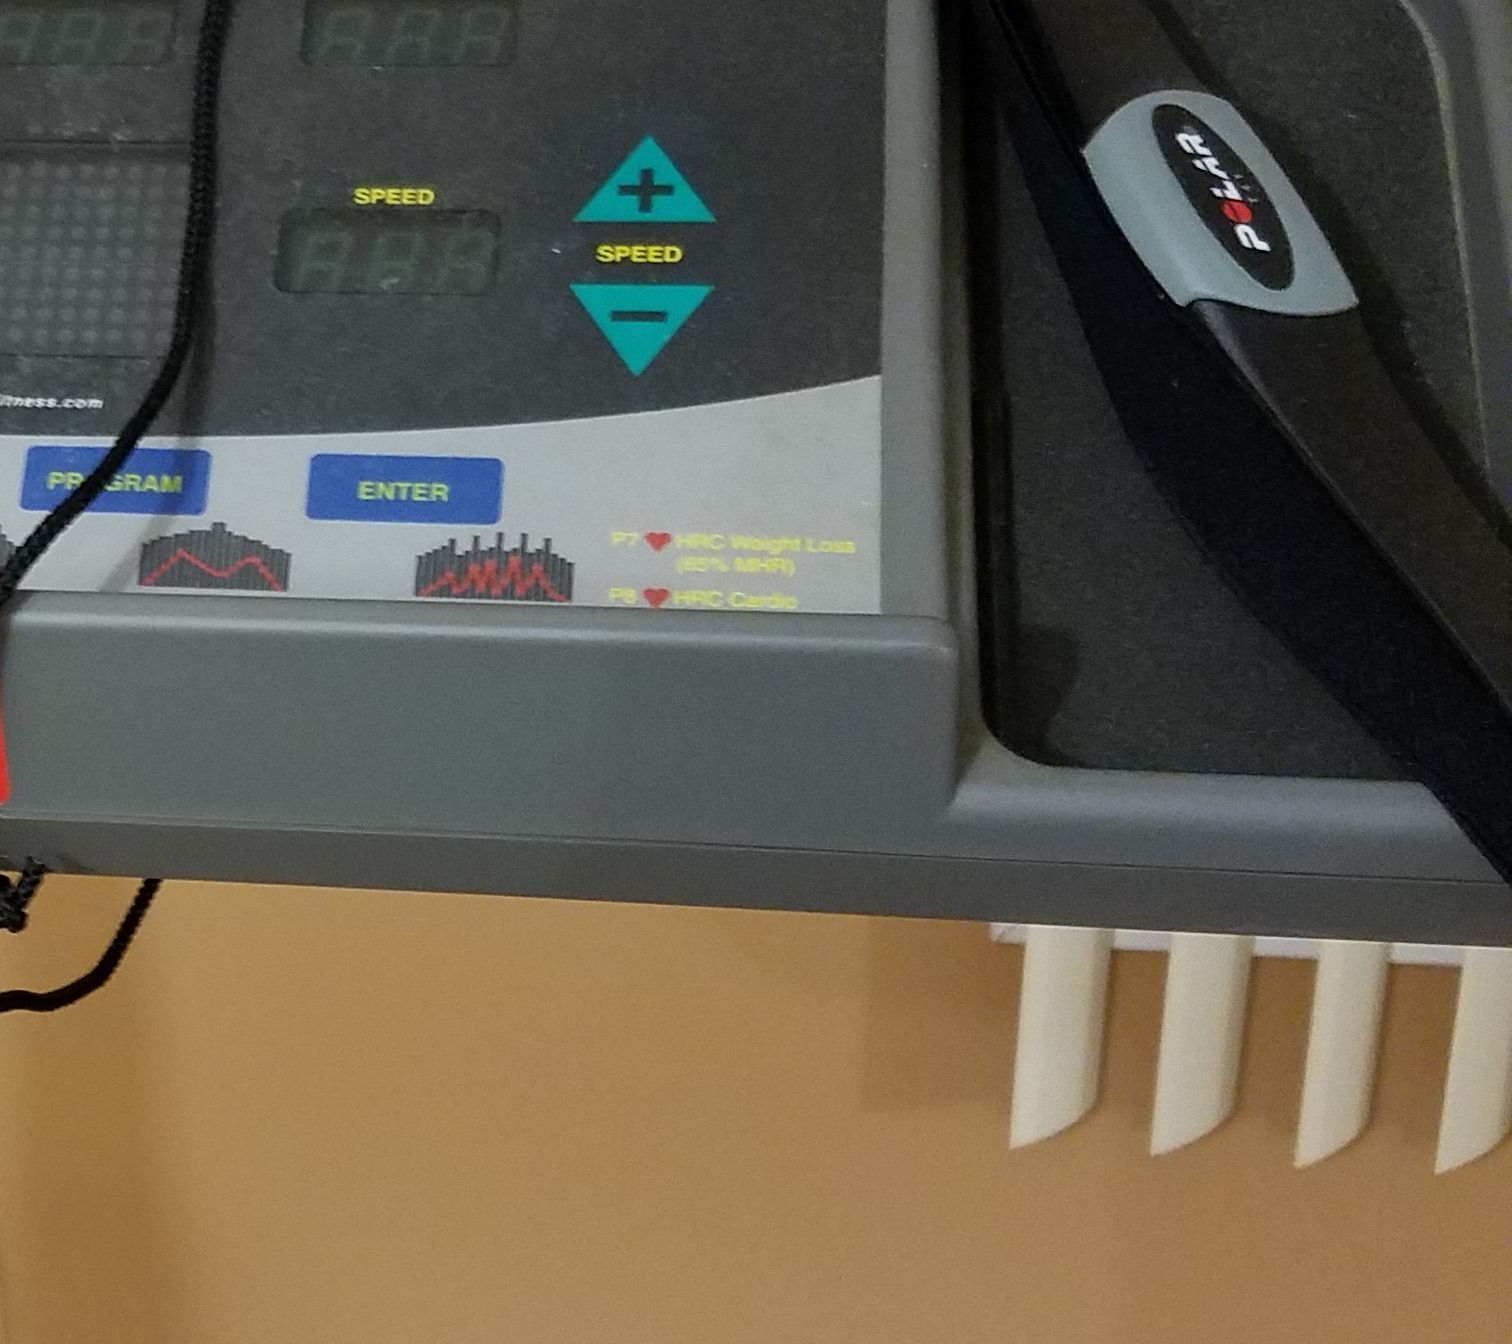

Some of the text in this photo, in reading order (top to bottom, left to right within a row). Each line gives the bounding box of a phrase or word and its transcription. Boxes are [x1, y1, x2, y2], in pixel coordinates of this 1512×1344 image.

[353, 187, 435, 205] SPEED
[1175, 132, 1271, 252] POLAR
[595, 244, 683, 263] SPEED
[46, 471, 184, 494] PRGRAM
[358, 481, 450, 502] ENTER
